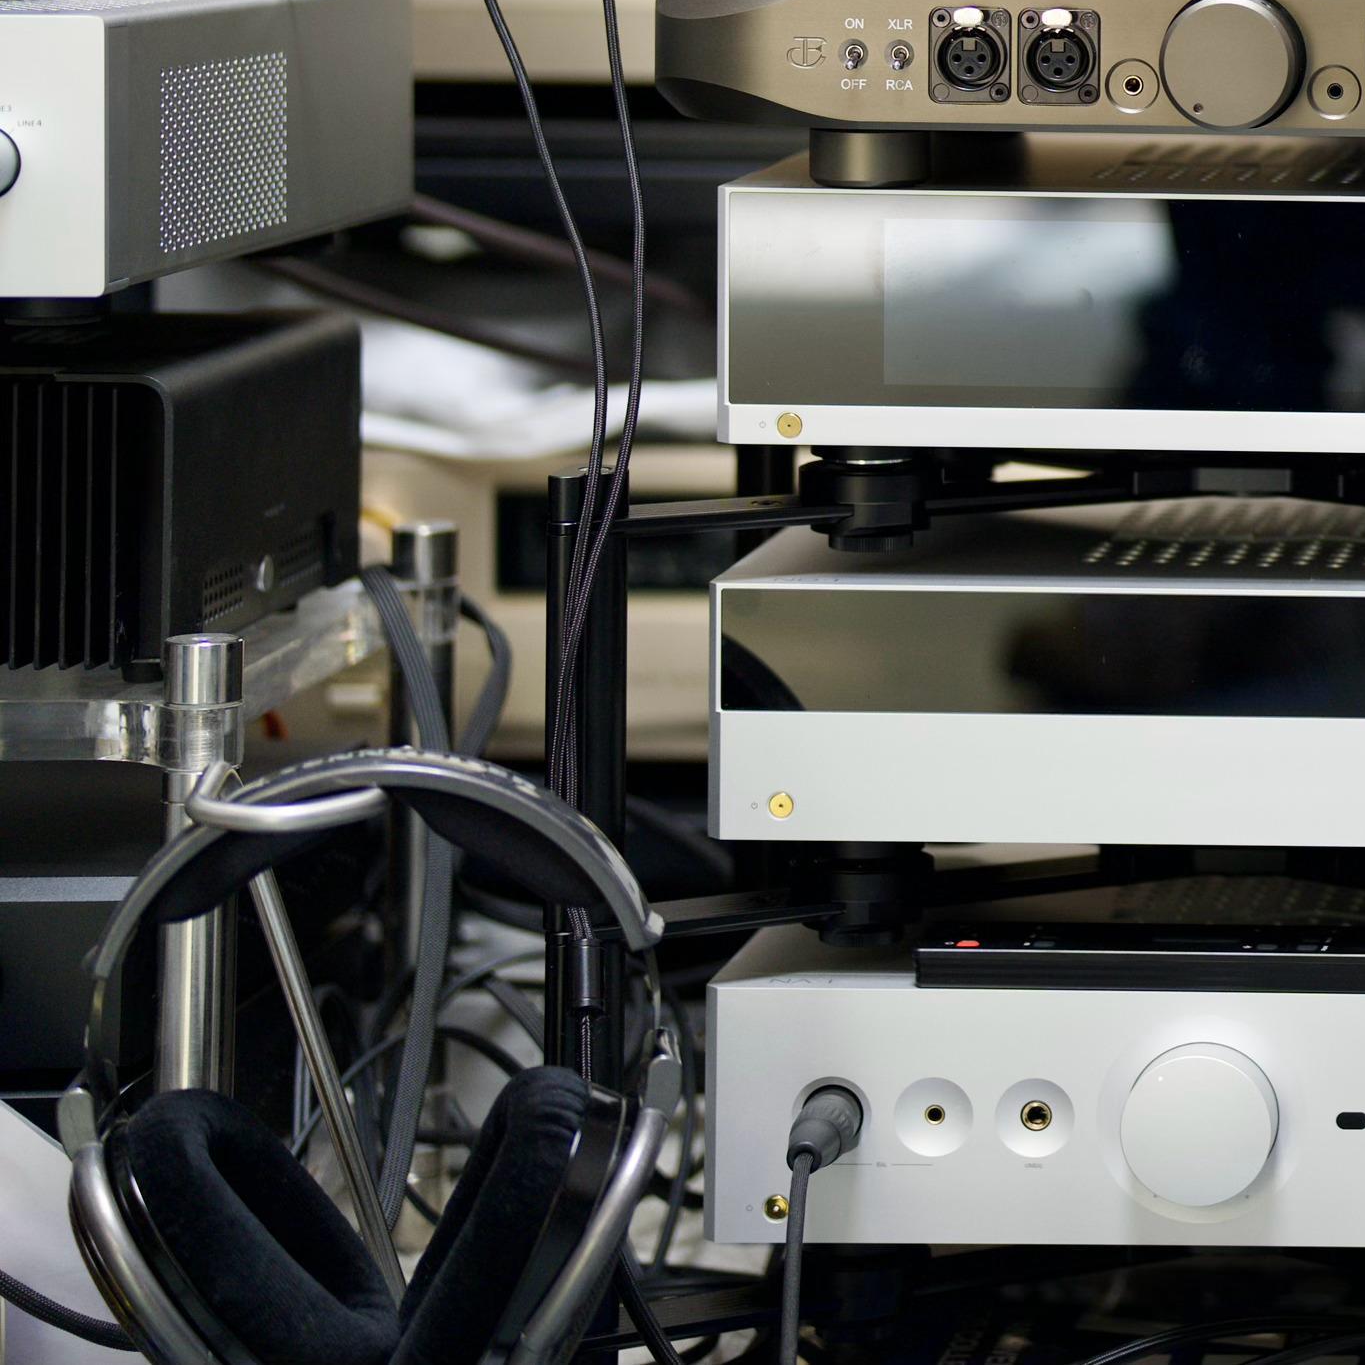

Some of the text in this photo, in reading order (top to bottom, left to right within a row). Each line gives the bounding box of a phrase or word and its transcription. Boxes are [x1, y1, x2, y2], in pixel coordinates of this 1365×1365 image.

[844, 17, 865, 30] ON
[887, 18, 913, 30] XLR
[840, 78, 868, 90] OFF
[885, 79, 914, 91] RCA
